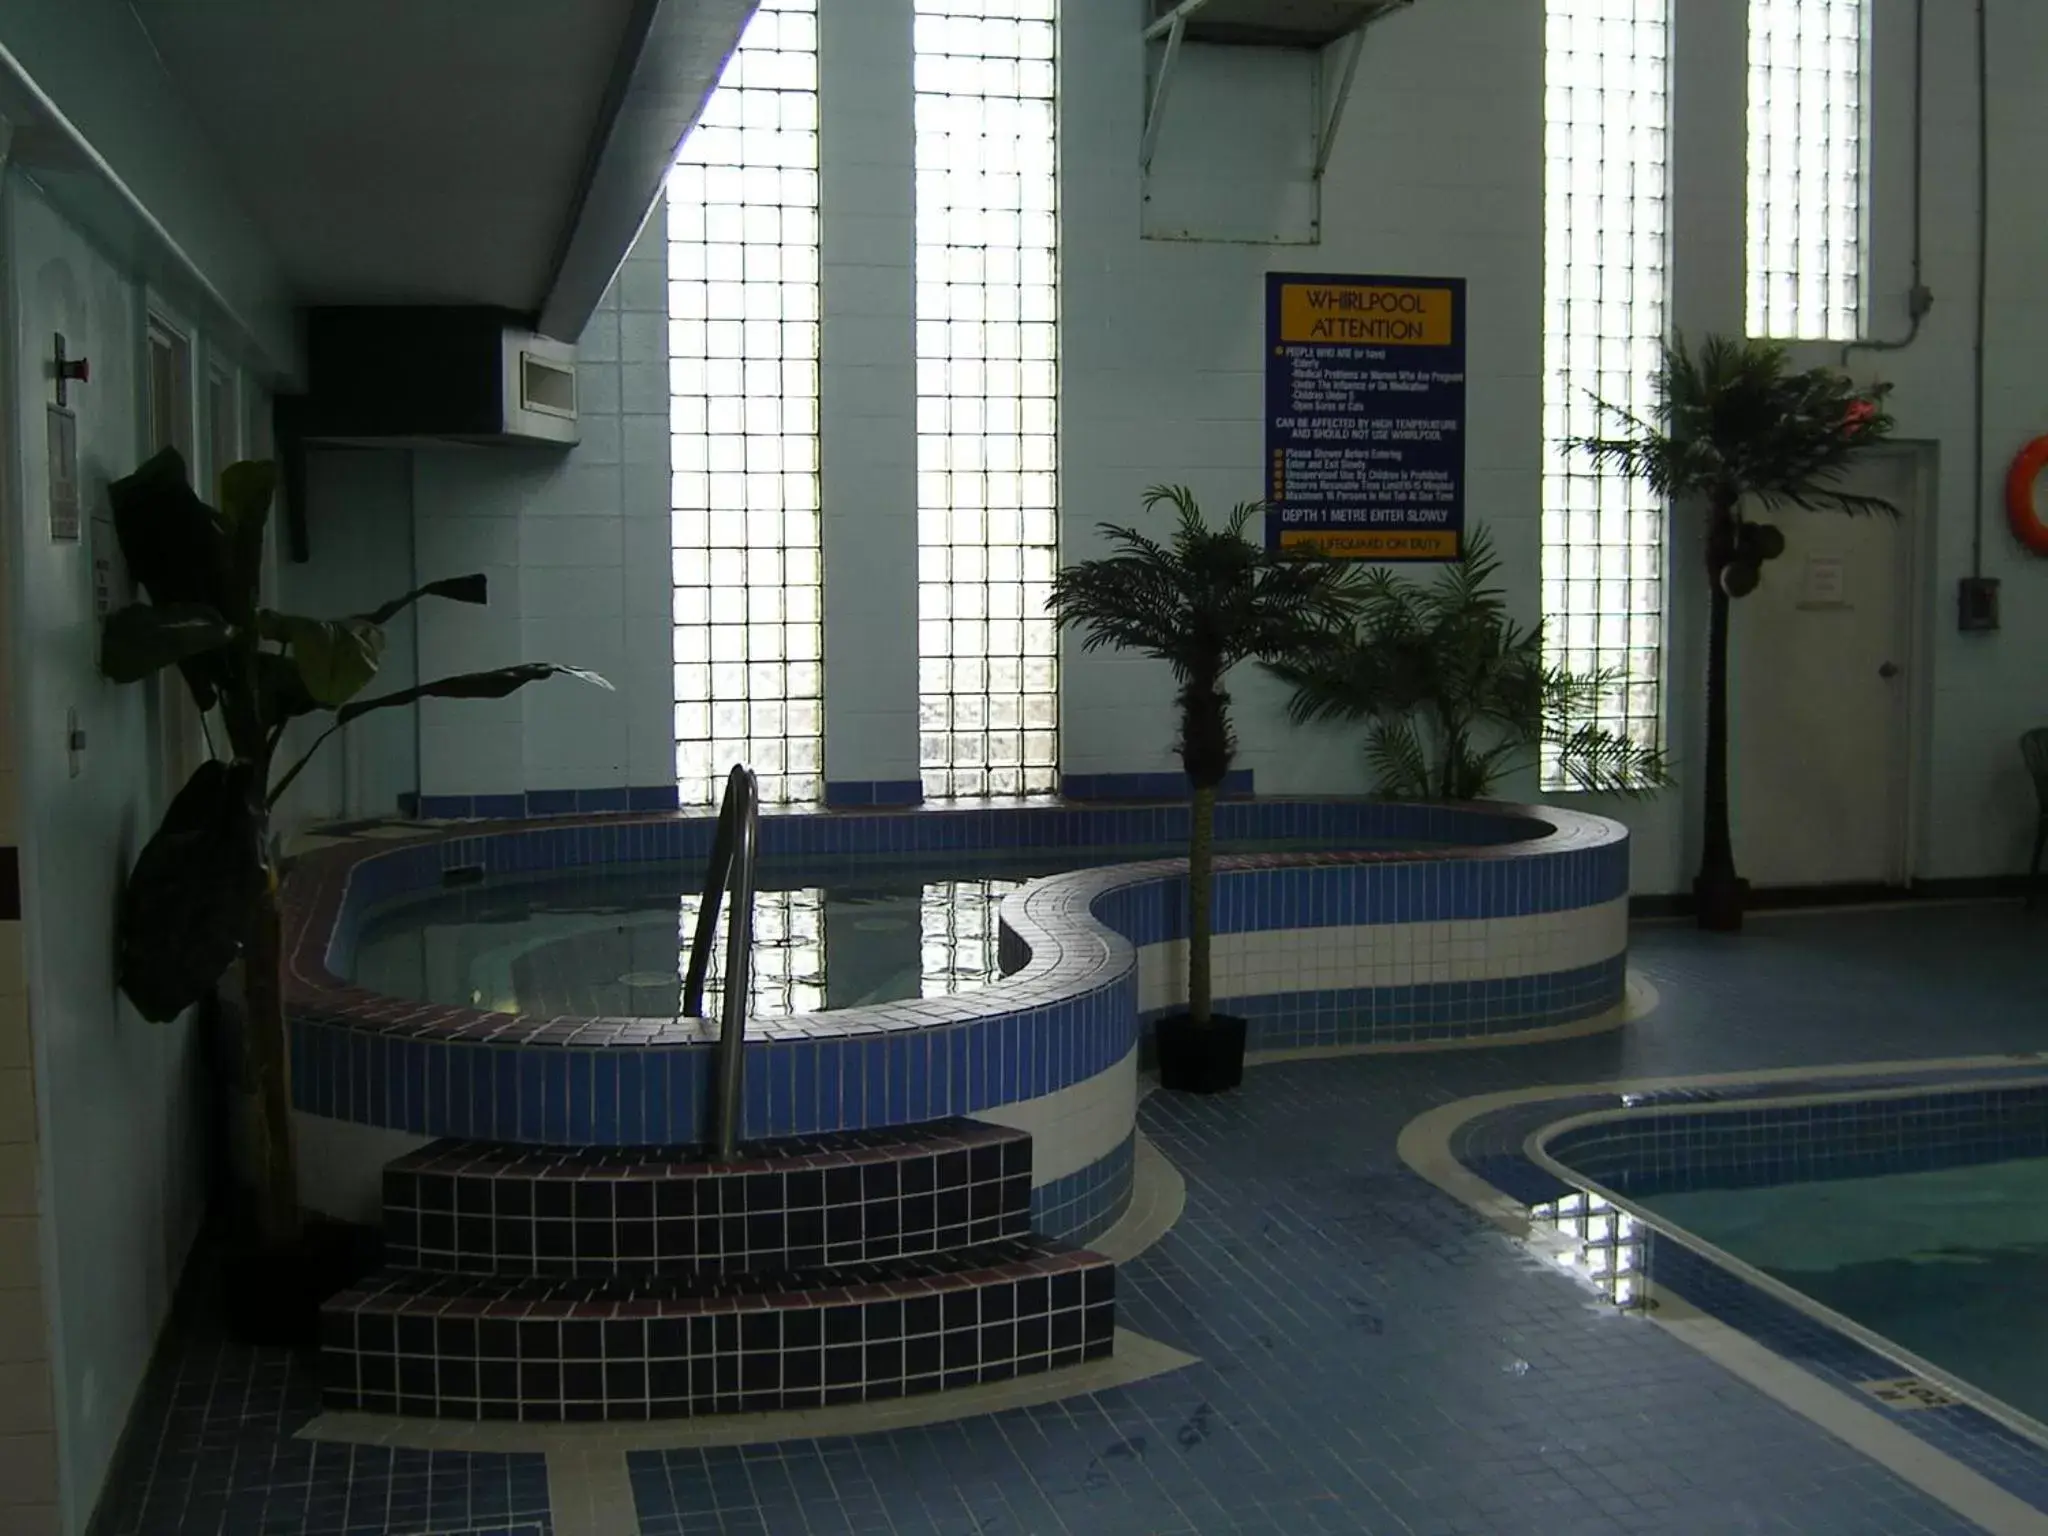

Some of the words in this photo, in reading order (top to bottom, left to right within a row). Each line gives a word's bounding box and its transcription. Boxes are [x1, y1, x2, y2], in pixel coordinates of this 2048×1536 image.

[1306, 290, 1426, 314] WHIRLPOOL
[1310, 317, 1424, 341] ATTENTION
[1286, 347, 1314, 357] PEOPLE
[1316, 348, 1335, 358] WHO
[1337, 348, 1351, 358] ARE
[1276, 417, 1295, 428] CAN
[1297, 417, 1308, 428] BE
[1311, 418, 1356, 428] AFFECTED
[1357, 418, 1369, 428] BY
[1371, 419, 1393, 429] HIGH
[1292, 428, 1310, 438] AND
[1312, 428, 1350, 439] SHOULD
[1351, 429, 1370, 439] NOT
[1371, 430, 1388, 440] USE
[1282, 508, 1317, 522] DEPTH
[1320, 508, 1327, 521] 1
[1330, 508, 1367, 522] METRE
[1370, 508, 1404, 522] ENTER
[1406, 508, 1448, 522] SLOWLY
[1410, 538, 1442, 551] DUTY
